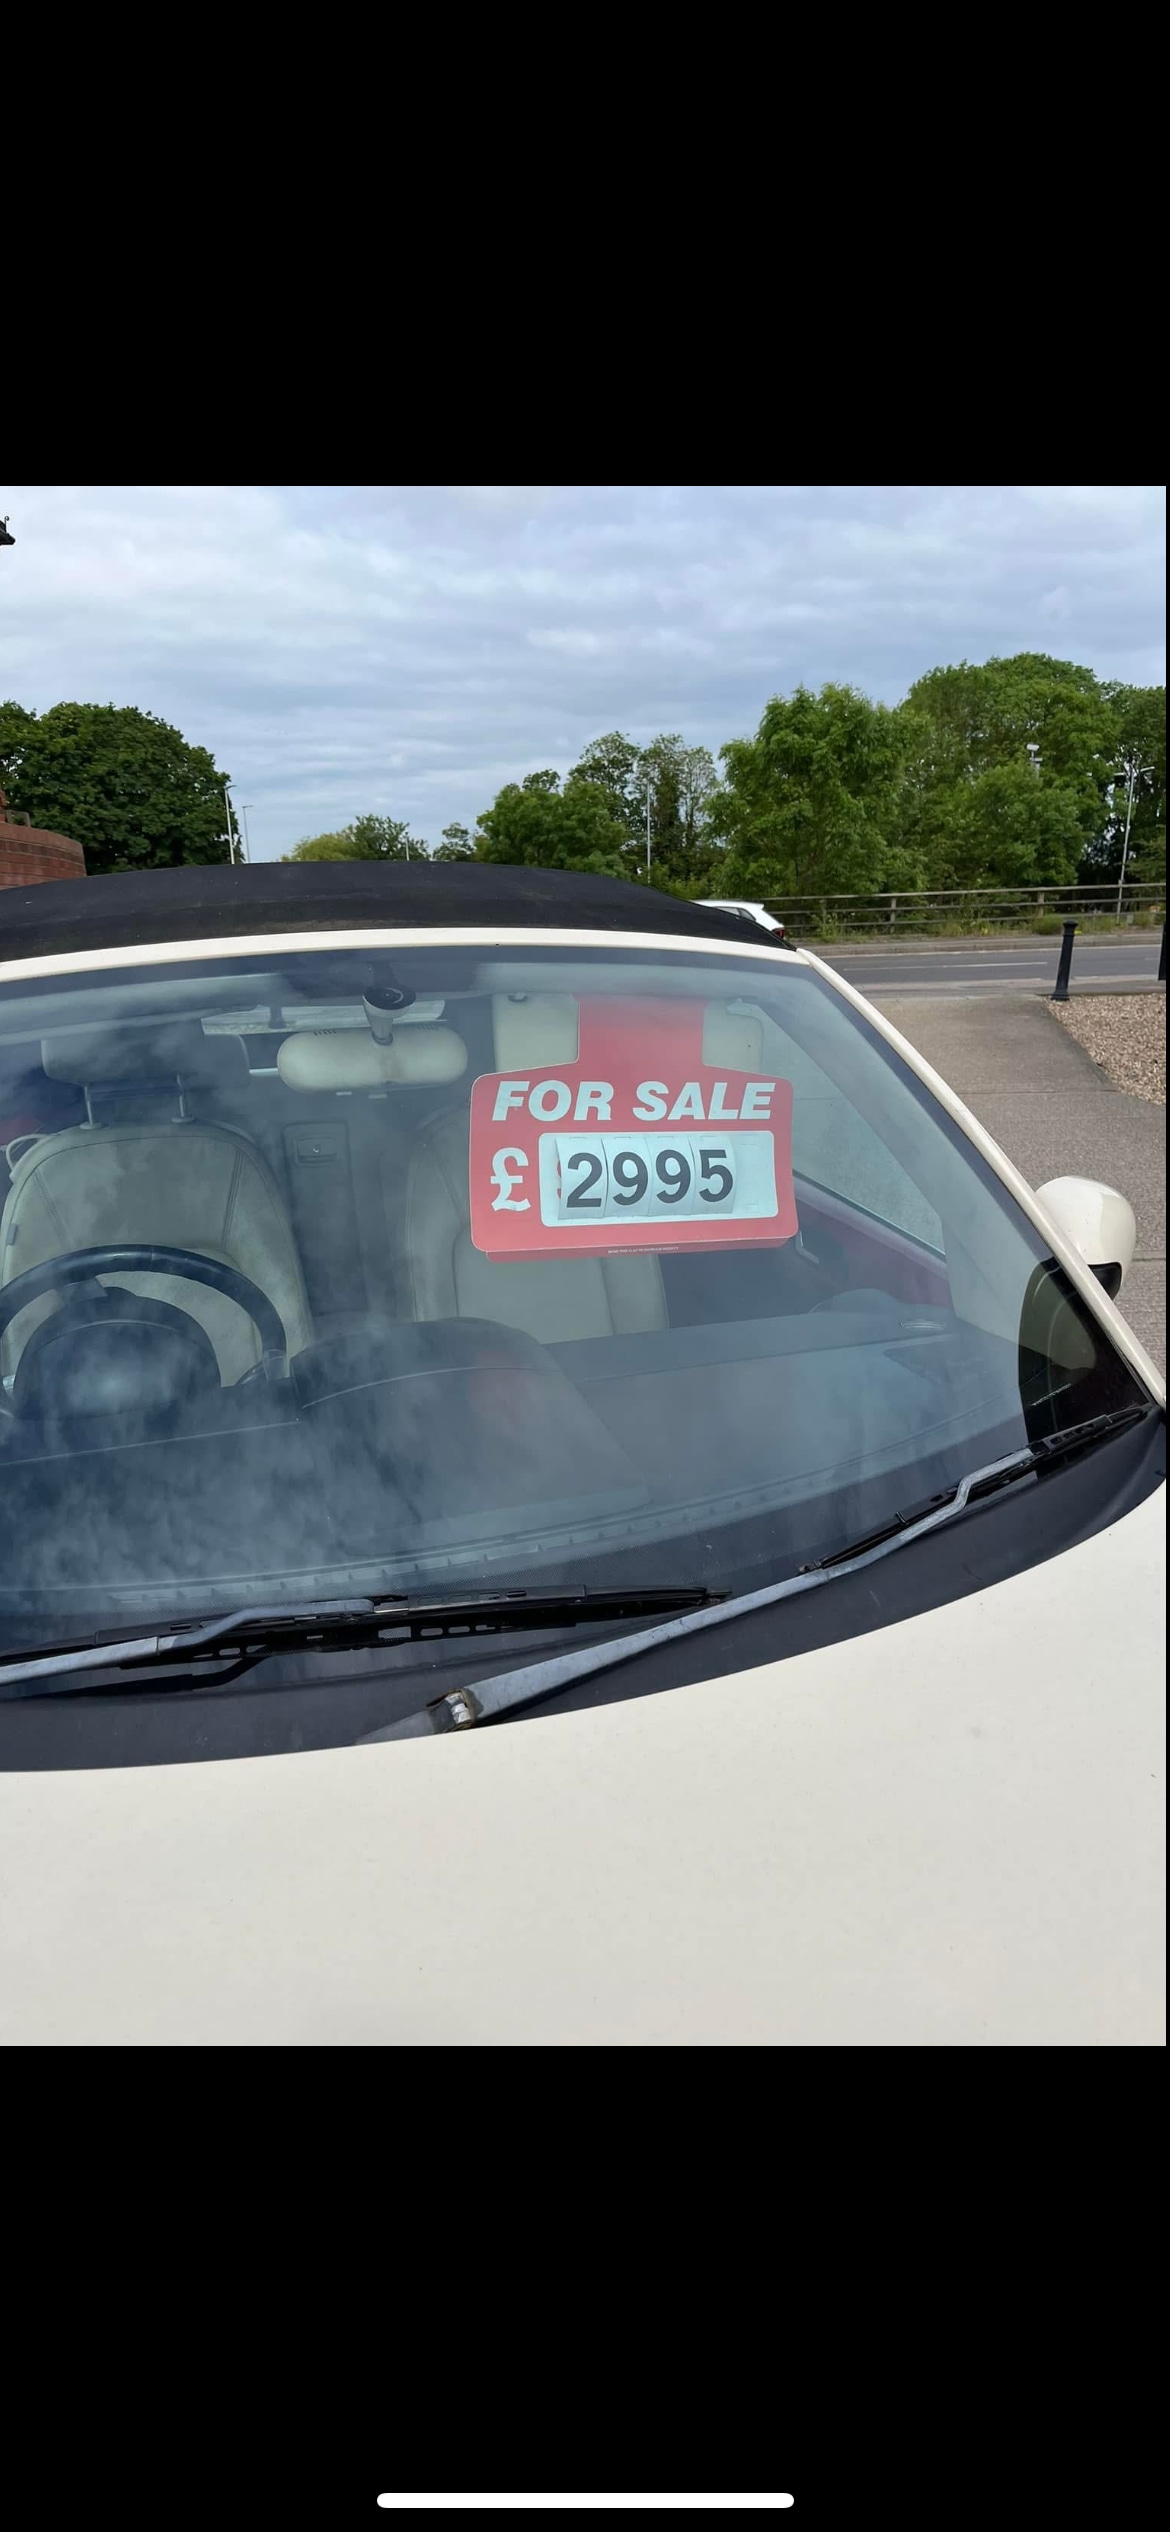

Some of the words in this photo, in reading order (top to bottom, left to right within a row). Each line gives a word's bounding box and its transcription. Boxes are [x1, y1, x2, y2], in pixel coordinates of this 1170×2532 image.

[491, 1079, 614, 1122] FOR
[632, 1081, 776, 1121] SALE
[566, 1149, 734, 1208] 2995
